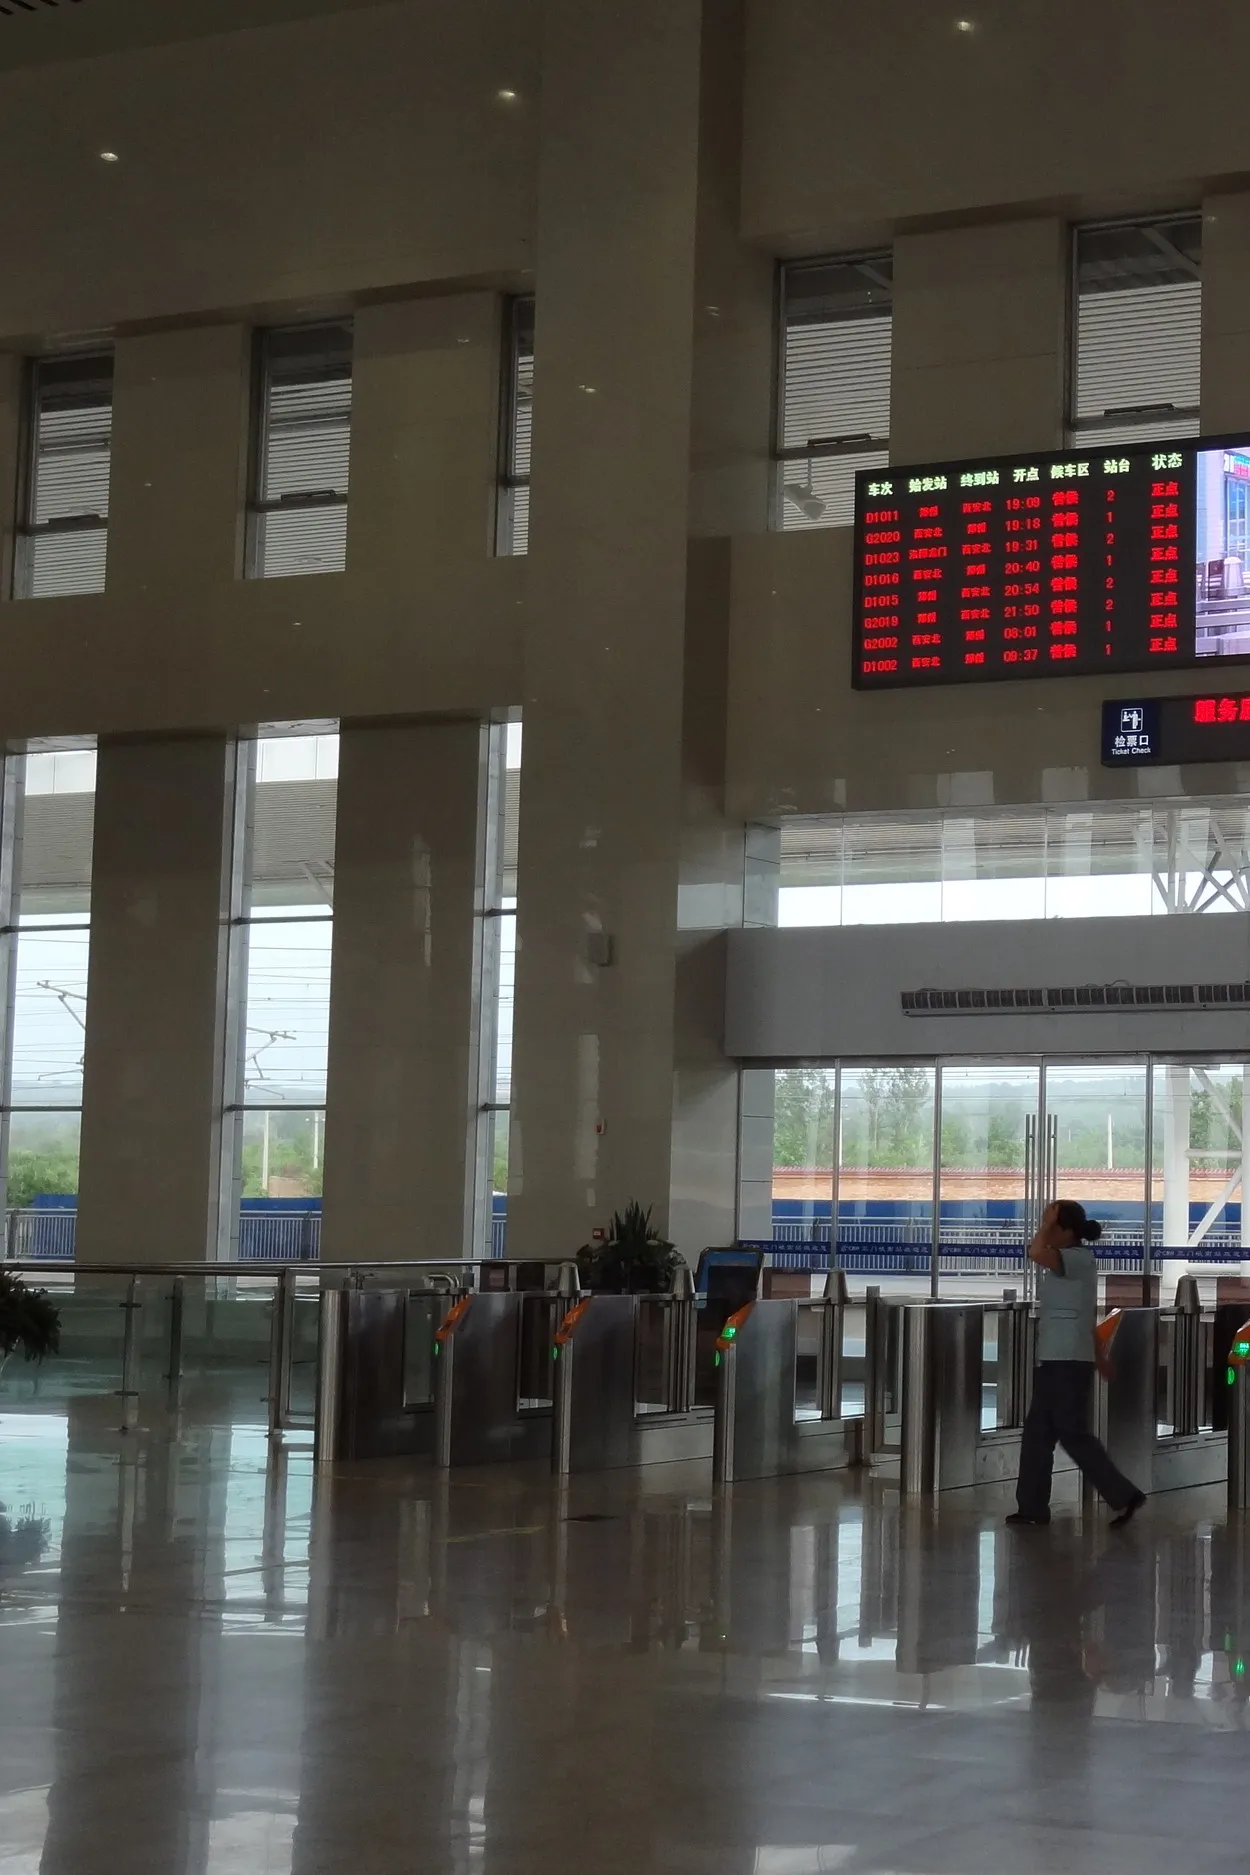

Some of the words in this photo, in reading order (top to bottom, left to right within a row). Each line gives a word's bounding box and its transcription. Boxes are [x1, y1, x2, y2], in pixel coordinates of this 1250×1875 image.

[868, 482, 894, 497] 车次
[908, 475, 948, 493] 始发站
[960, 470, 1000, 487] 终到站
[1012, 467, 1040, 483] 开点
[1050, 462, 1090, 479] 候车区
[1103, 458, 1131, 474] 站台
[1151, 452, 1183, 471] 状态
[865, 510, 899, 524] D1011
[1005, 496, 1042, 511] 19:09
[1106, 489, 1116, 502] 2
[1150, 480, 1179, 498] 正点
[864, 551, 901, 566] D1023
[1005, 539, 1039, 553] 19:31
[1106, 532, 1115, 545] 2
[1150, 523, 1179, 540] 正点
[865, 530, 901, 545] G2020
[1005, 517, 1041, 532] 19:18
[1106, 512, 1113, 522] 1
[1150, 502, 1179, 520] 正点
[864, 572, 900, 587] D1016
[1004, 559, 1041, 575] 20:40
[1106, 555, 1113, 565] 1
[1150, 545, 1179, 562] 正点
[863, 594, 900, 609] D1015
[1004, 582, 1041, 597] 20:54
[1105, 576, 1114, 589] 2
[1149, 567, 1179, 585] 正点
[863, 615, 899, 629] G2019
[1003, 603, 1041, 618] 21:50
[1105, 598, 1114, 611] 2
[1149, 590, 1179, 607] 正点
[863, 636, 899, 651] G2002
[1105, 620, 1112, 631] 1
[1149, 612, 1178, 629] 正点
[862, 659, 898, 673] D1002
[1002, 648, 1039, 663] 09:37
[1105, 644, 1112, 654] 1
[1148, 636, 1178, 653] 正点
[1114, 735, 1149, 748] 检票口
[1131, 747, 1152, 755] Check
